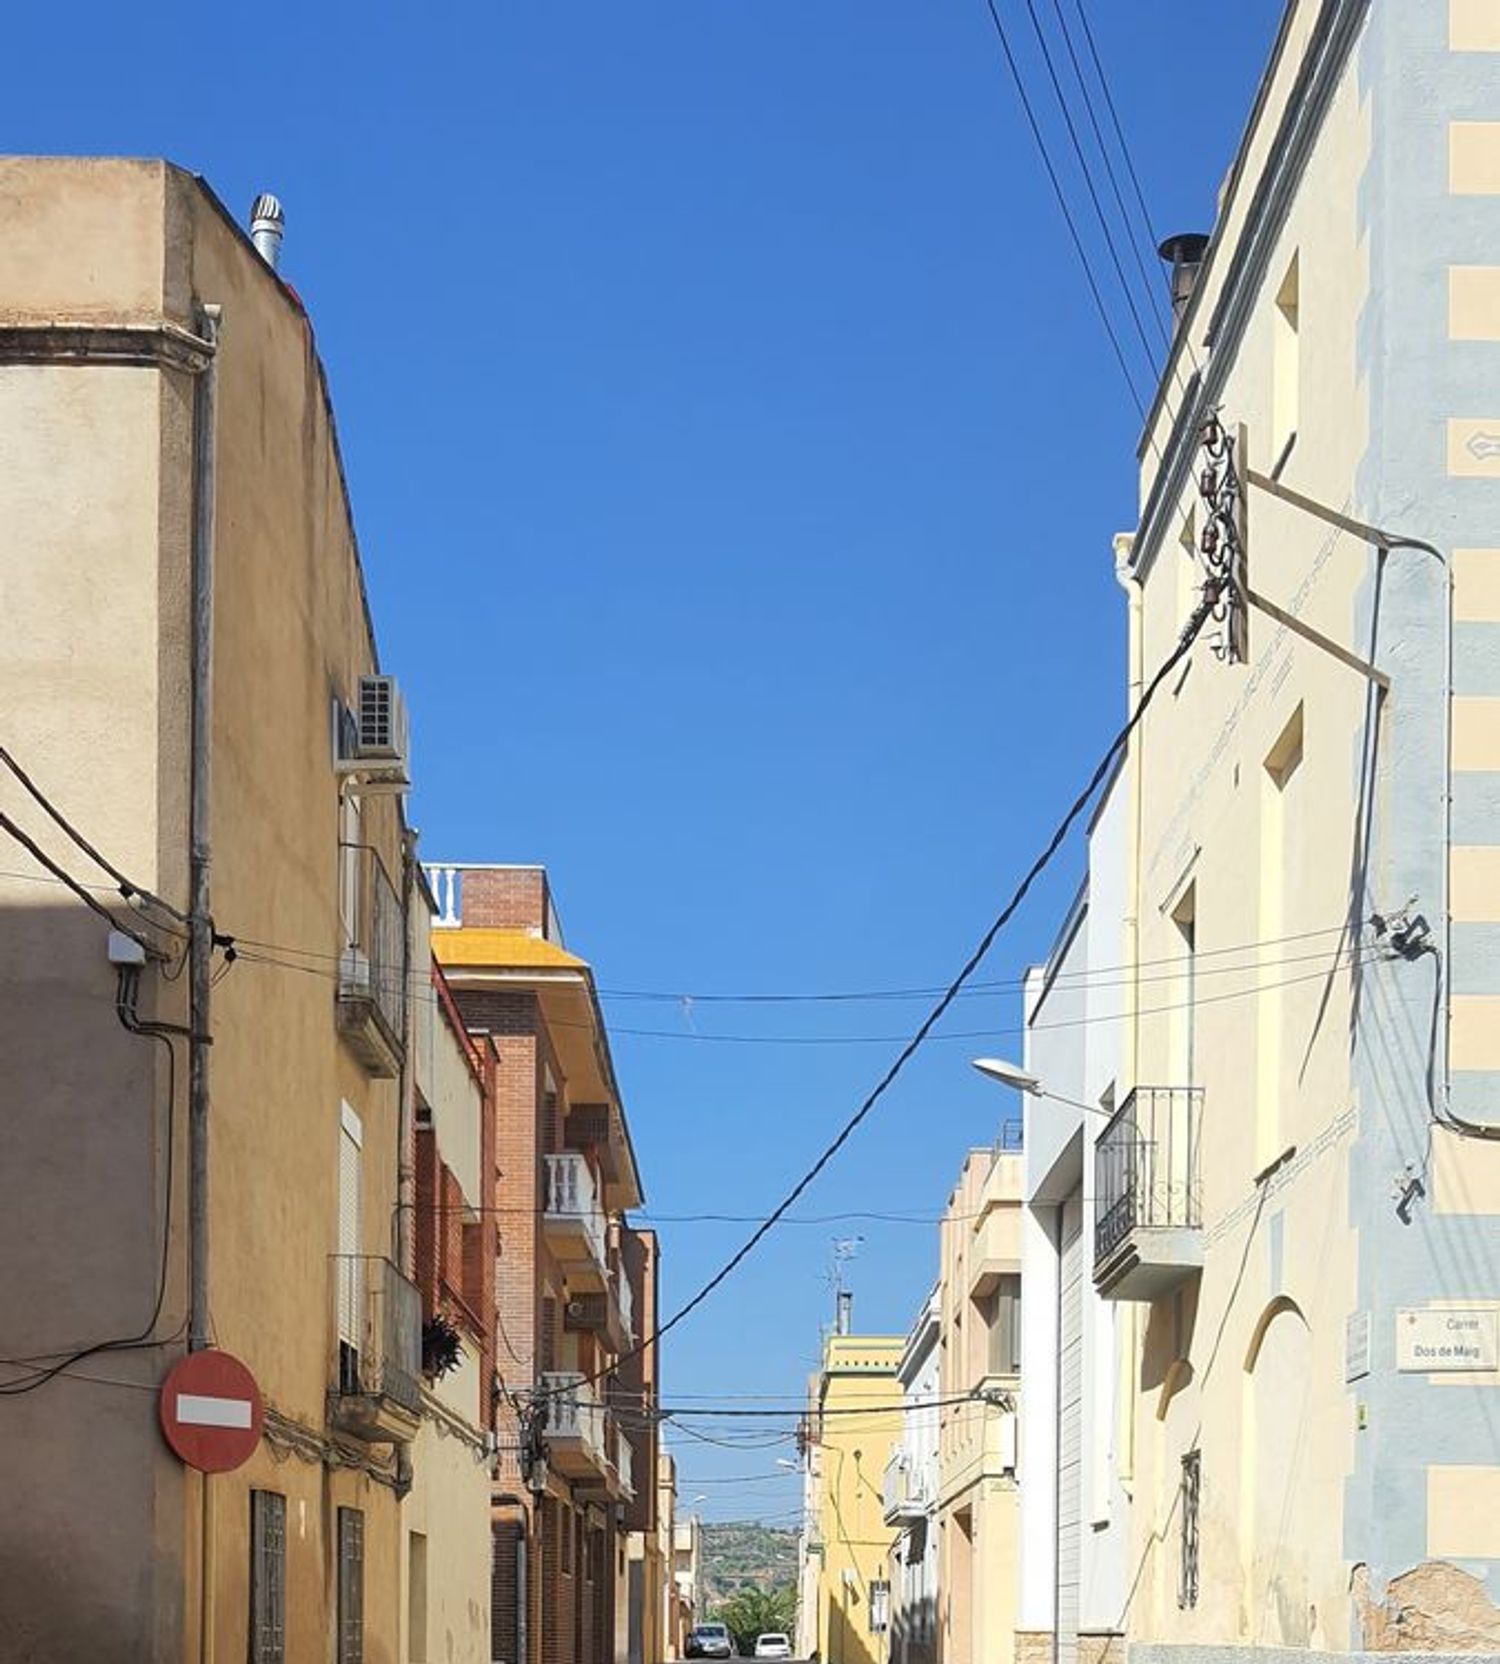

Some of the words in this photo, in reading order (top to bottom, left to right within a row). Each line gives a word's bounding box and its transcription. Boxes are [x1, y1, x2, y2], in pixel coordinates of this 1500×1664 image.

[1414, 1345, 1437, 1357] Dos
[1438, 1345, 1452, 1357] de
[1453, 1345, 1480, 1359] Maig
